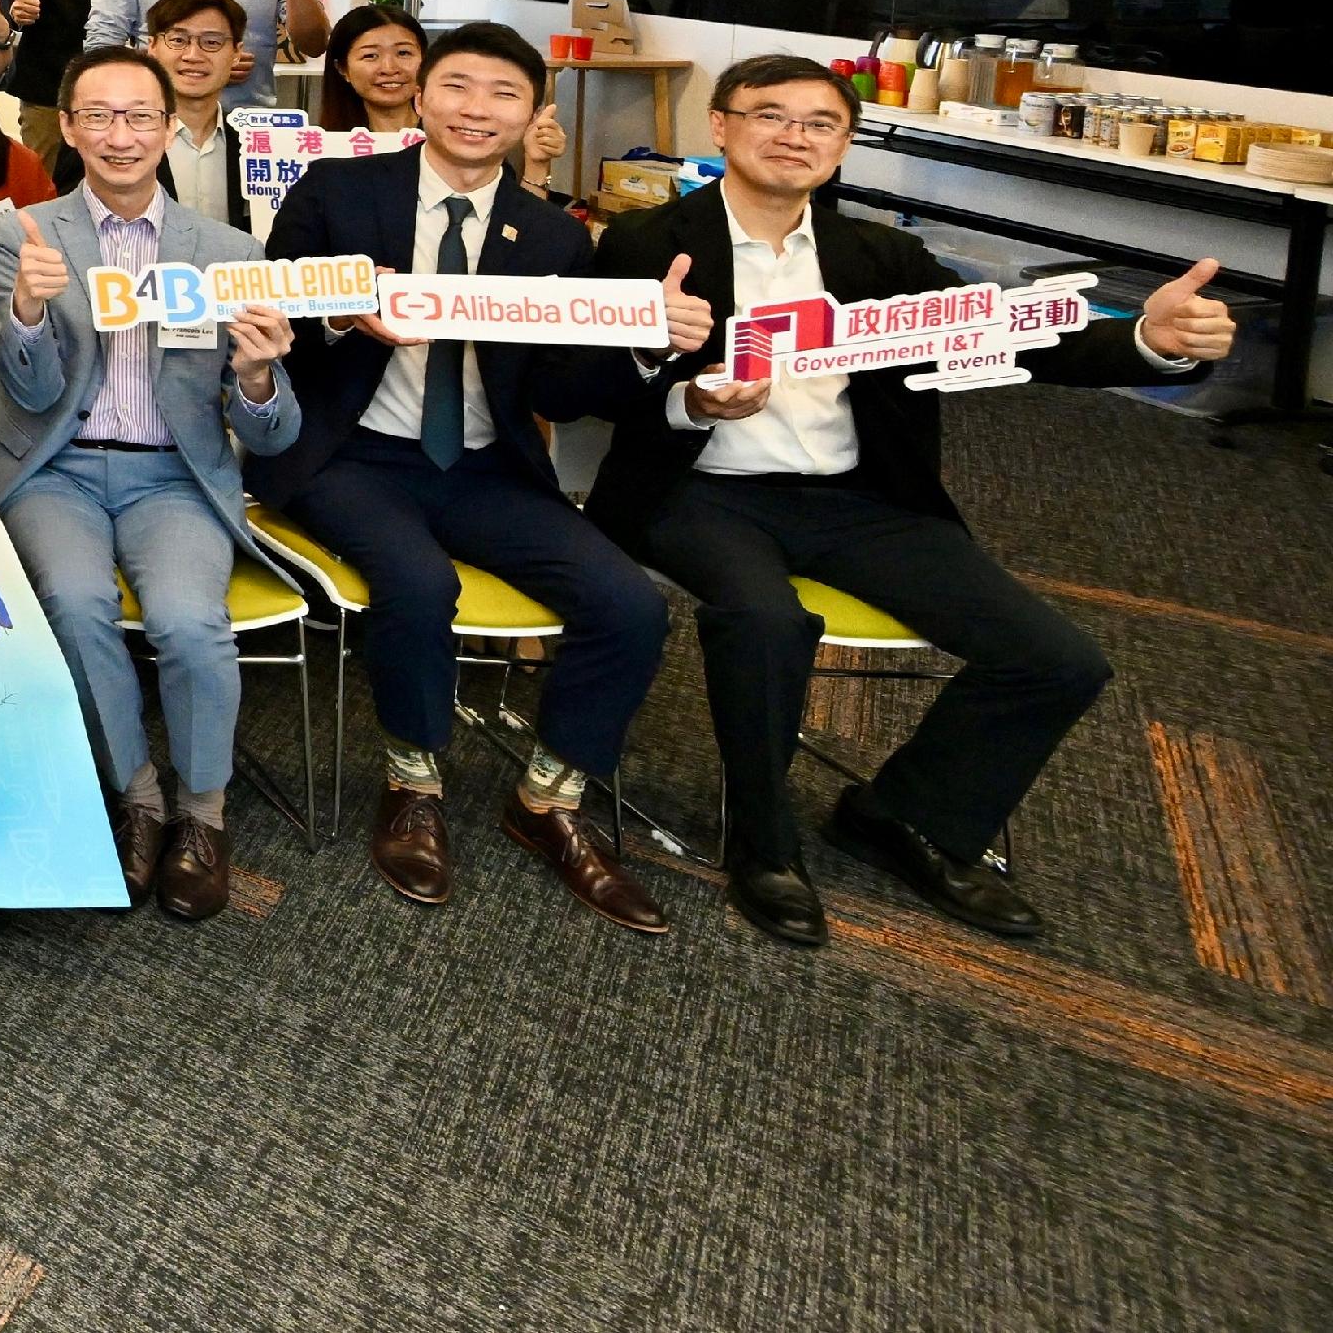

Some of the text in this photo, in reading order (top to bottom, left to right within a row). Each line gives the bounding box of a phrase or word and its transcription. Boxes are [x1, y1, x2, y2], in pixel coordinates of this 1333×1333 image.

[247, 184, 280, 198] Hong
[95, 268, 206, 327] B4B
[279, 299, 374, 314] For Business
[450, 295, 658, 327] Alibaba Cloud
[846, 287, 1079, 339] 政府創科 活動
[793, 332, 985, 374] Government I&T
[947, 351, 1007, 372] event
